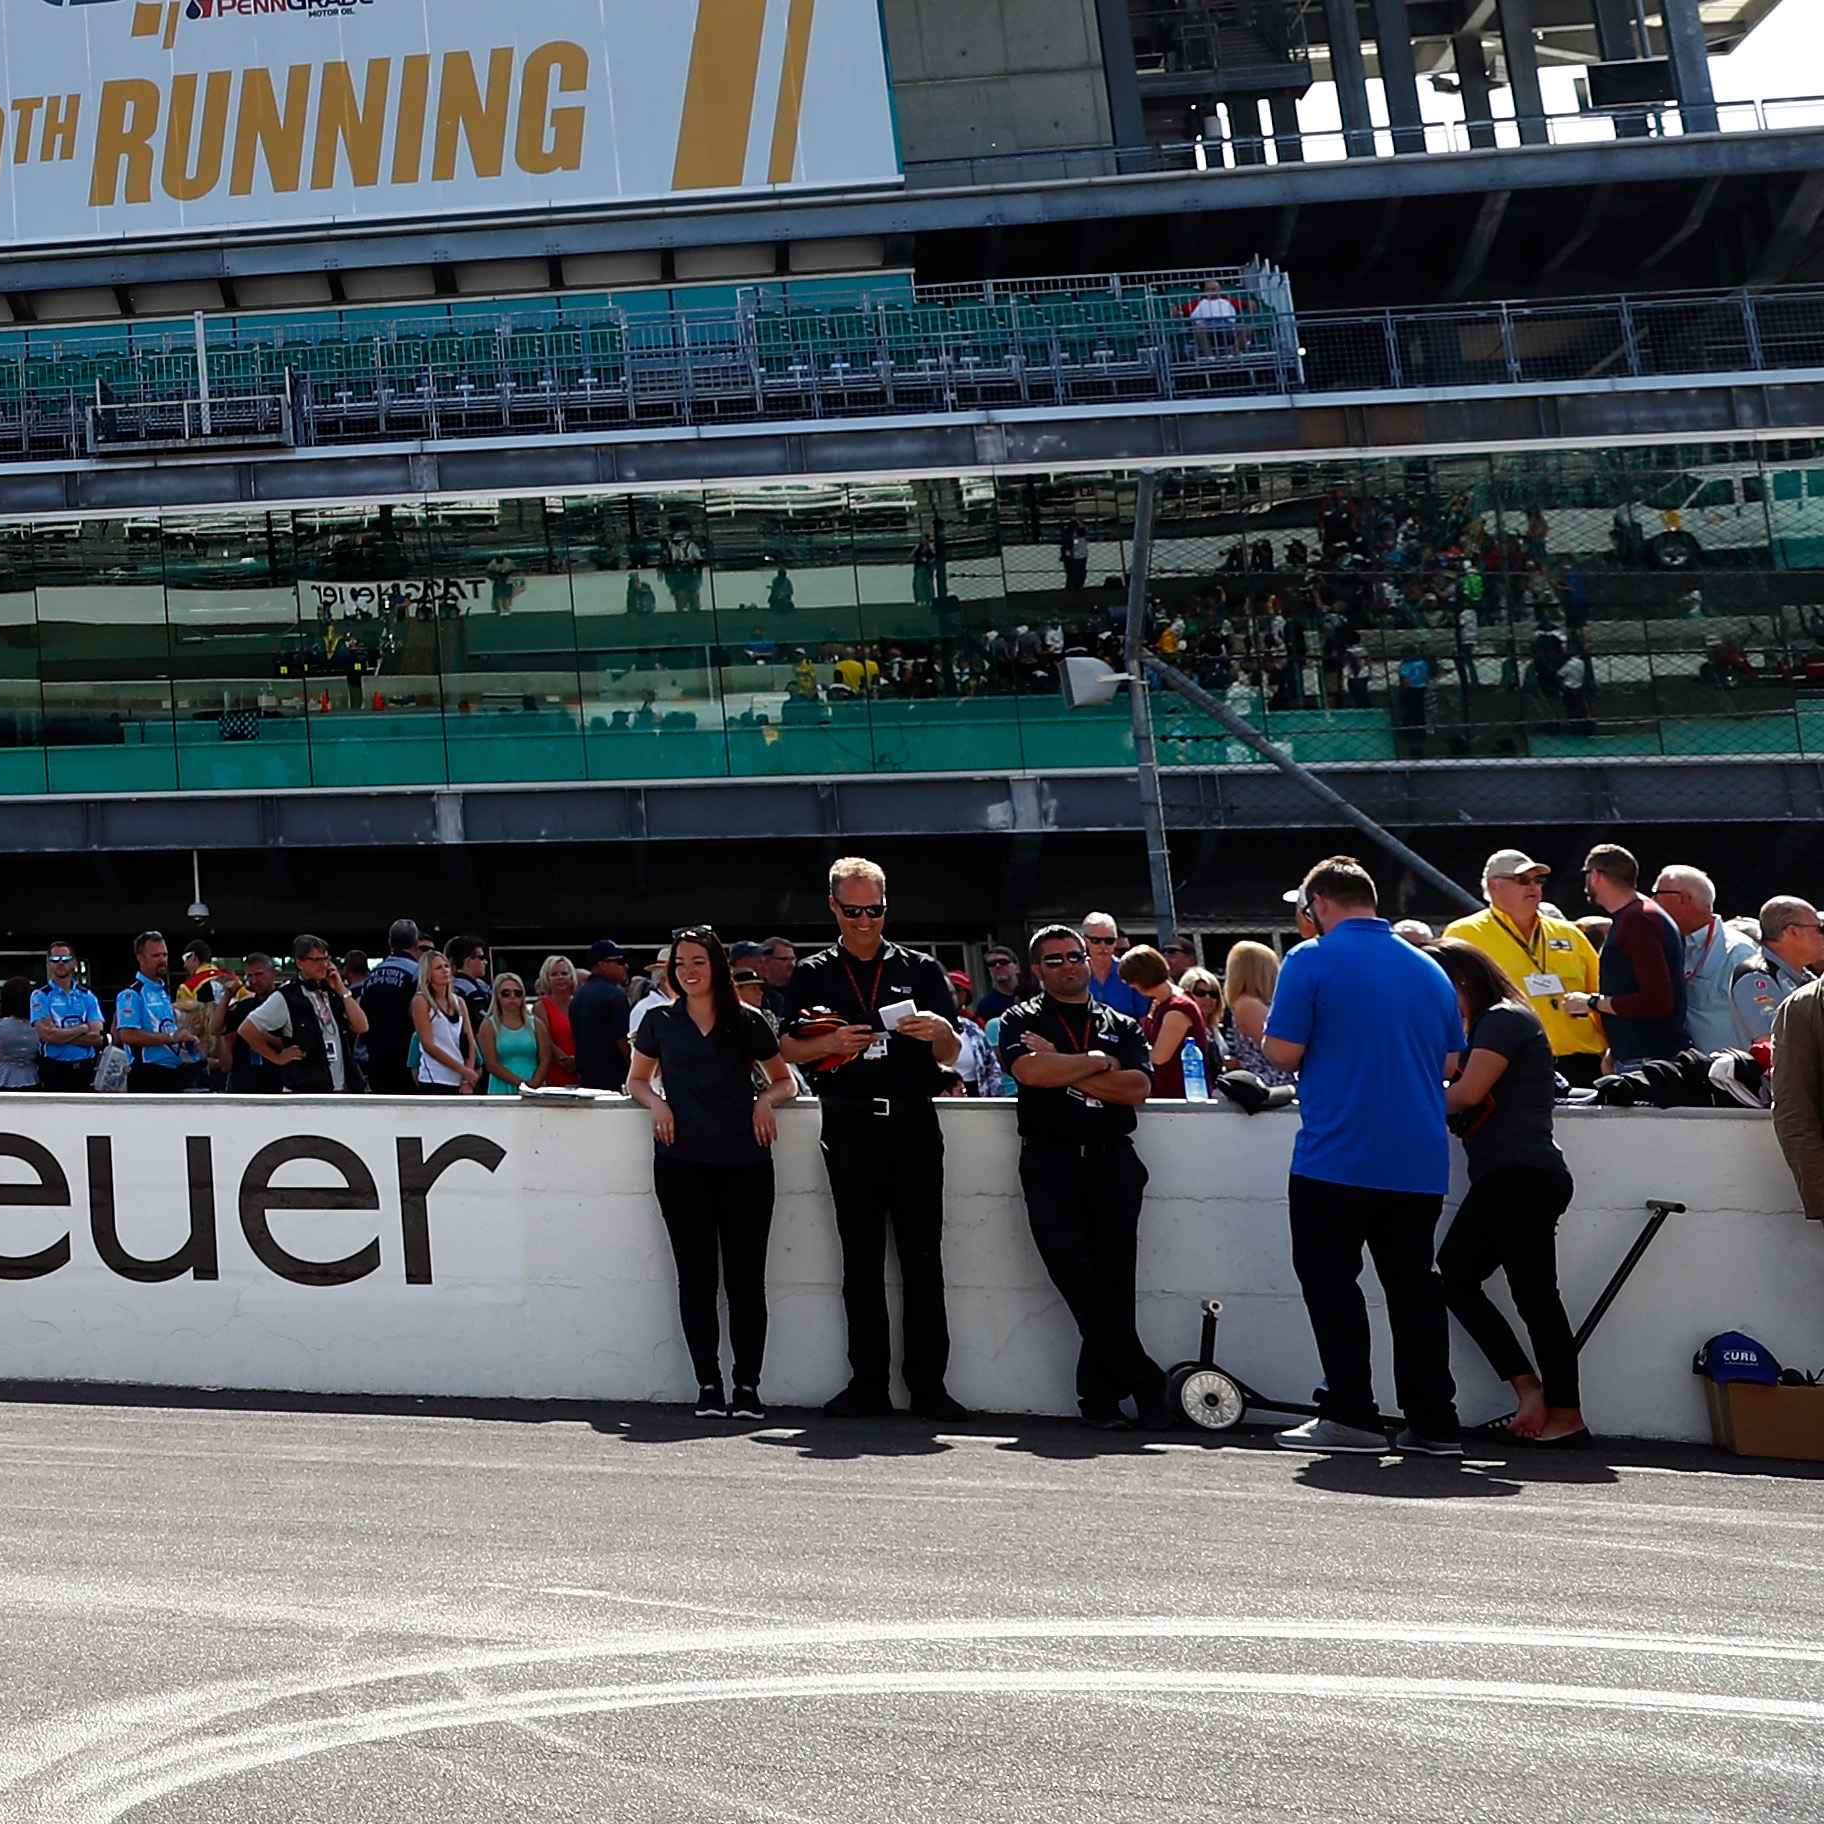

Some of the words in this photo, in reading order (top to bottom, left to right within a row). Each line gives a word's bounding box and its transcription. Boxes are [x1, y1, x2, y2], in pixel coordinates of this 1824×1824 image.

[309, 9, 339, 18] MOTOR
[89, 39, 590, 209] RUNNING
[1723, 1351, 1758, 1363] CURB
